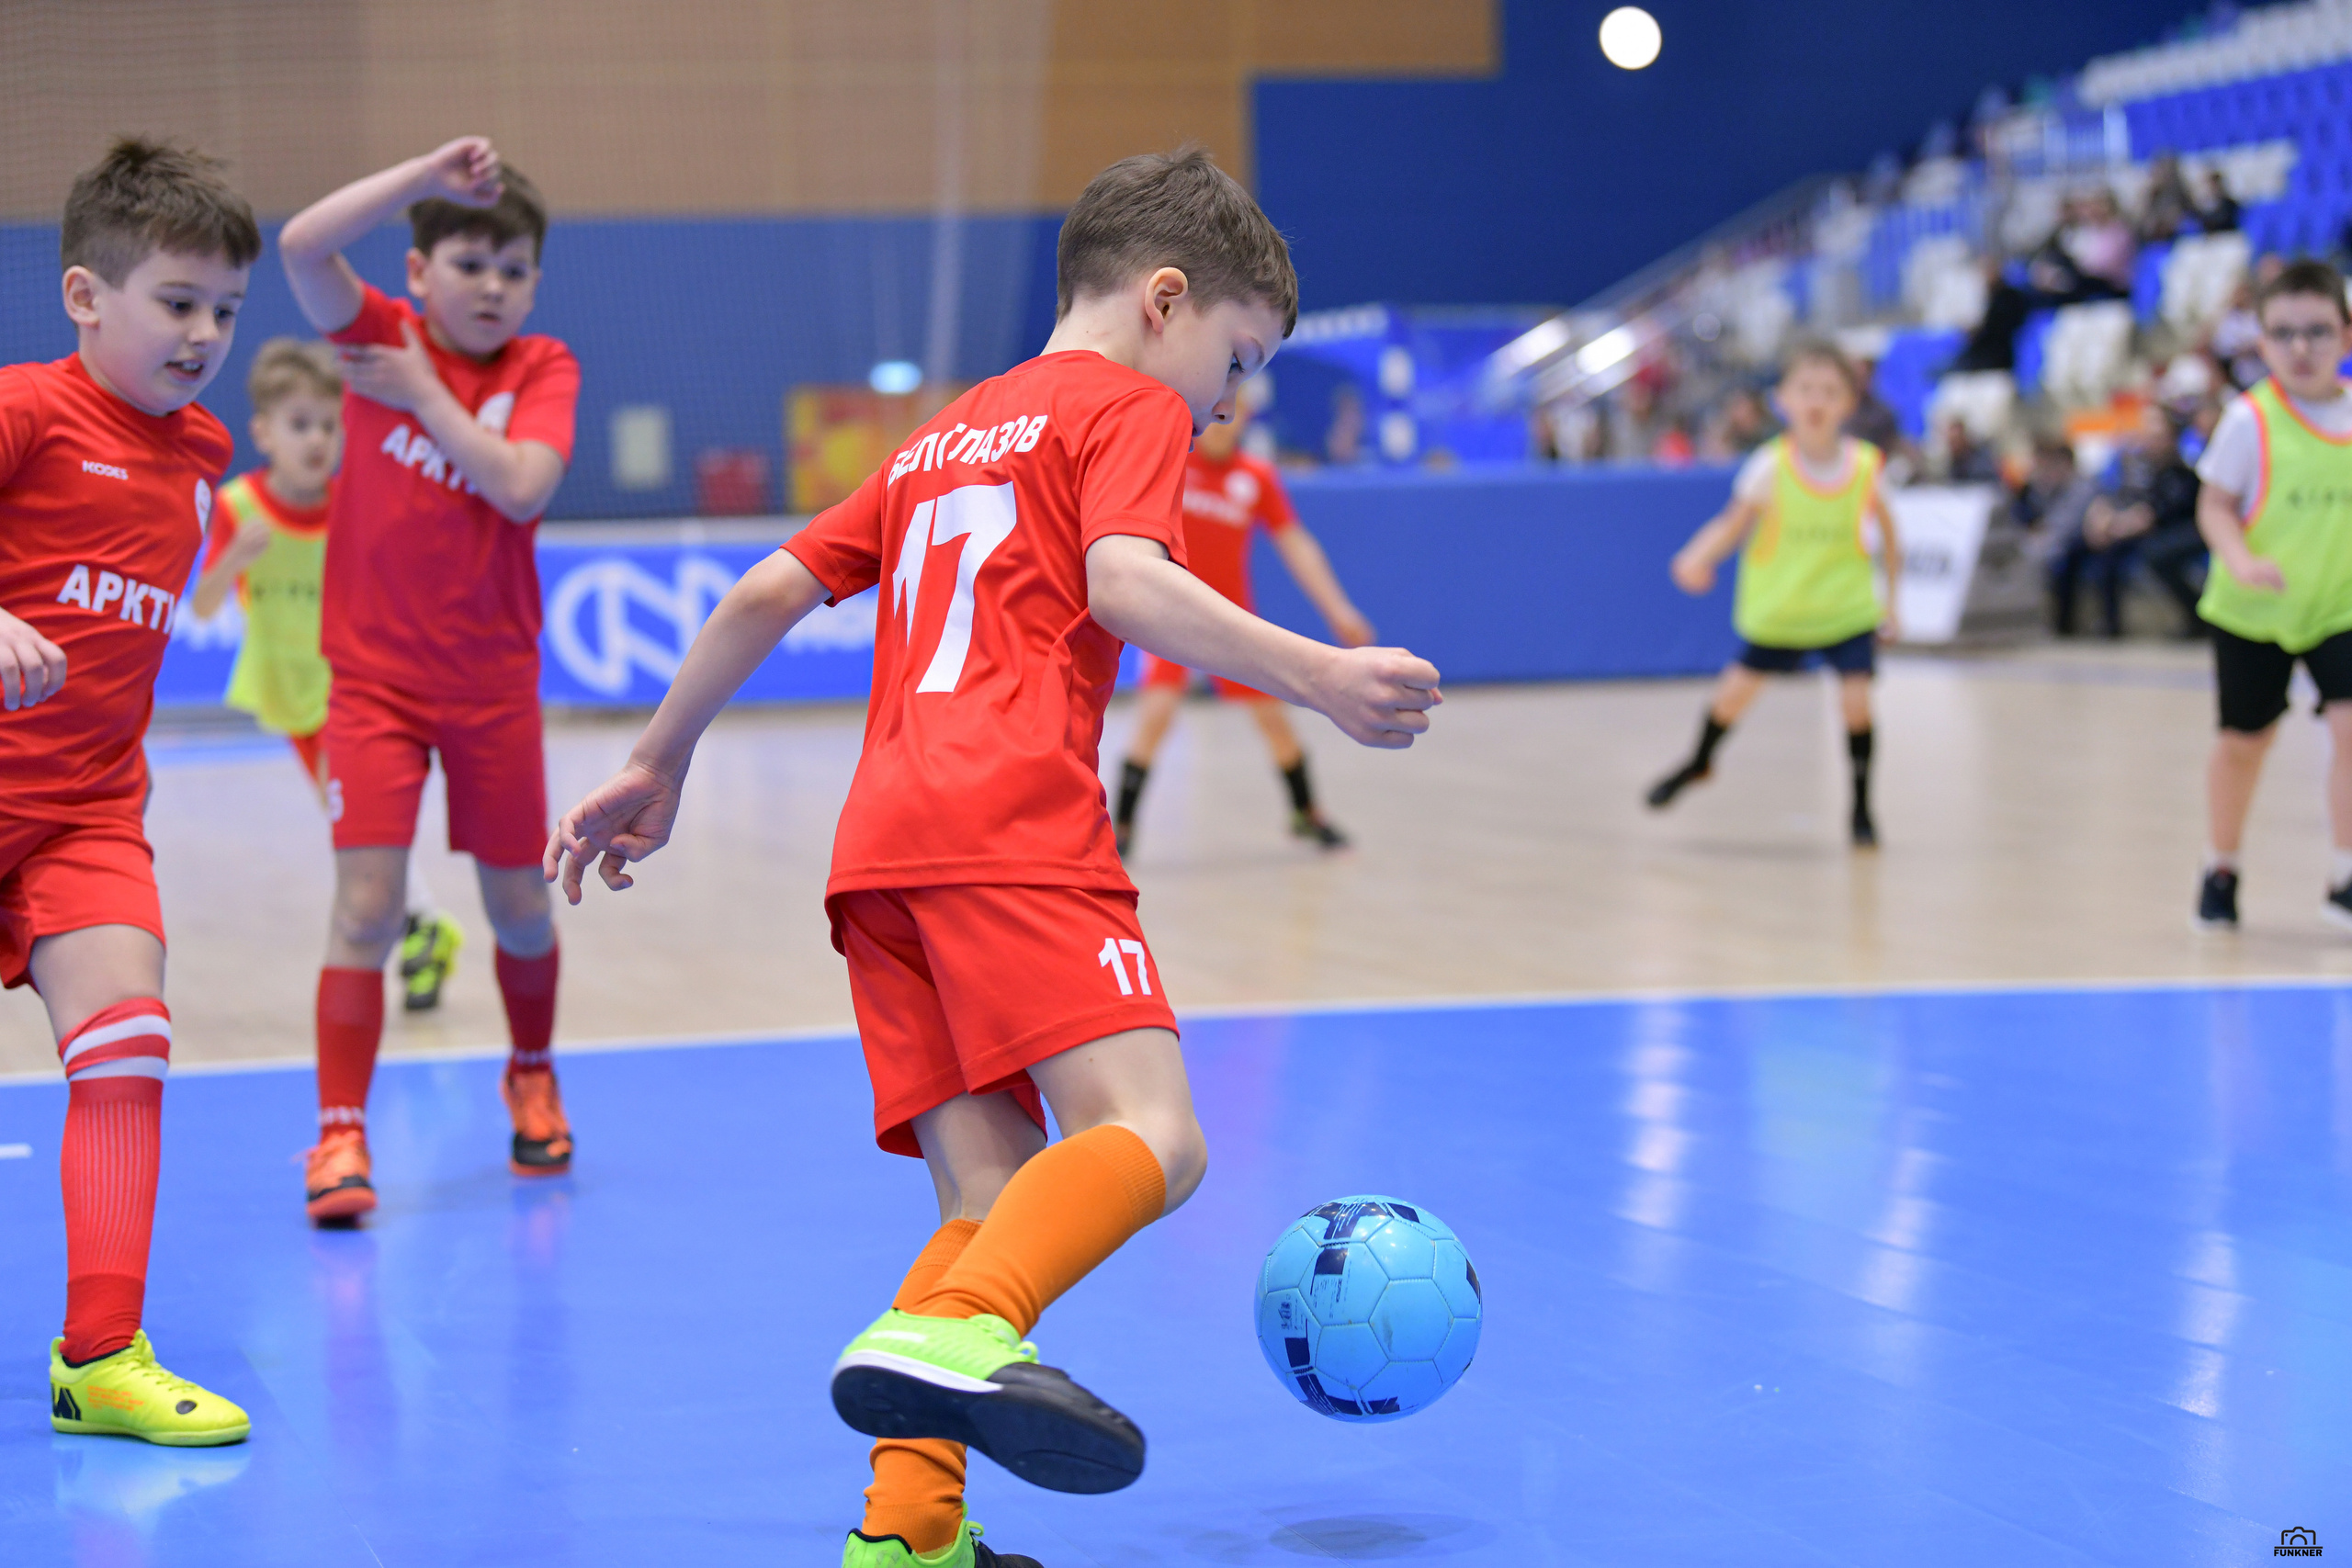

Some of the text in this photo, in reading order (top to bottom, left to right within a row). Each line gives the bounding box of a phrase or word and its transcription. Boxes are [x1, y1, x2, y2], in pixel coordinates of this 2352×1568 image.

[380, 423, 478, 495] АРК
[892, 480, 1017, 694] 17
[1098, 937, 1152, 996] 17
